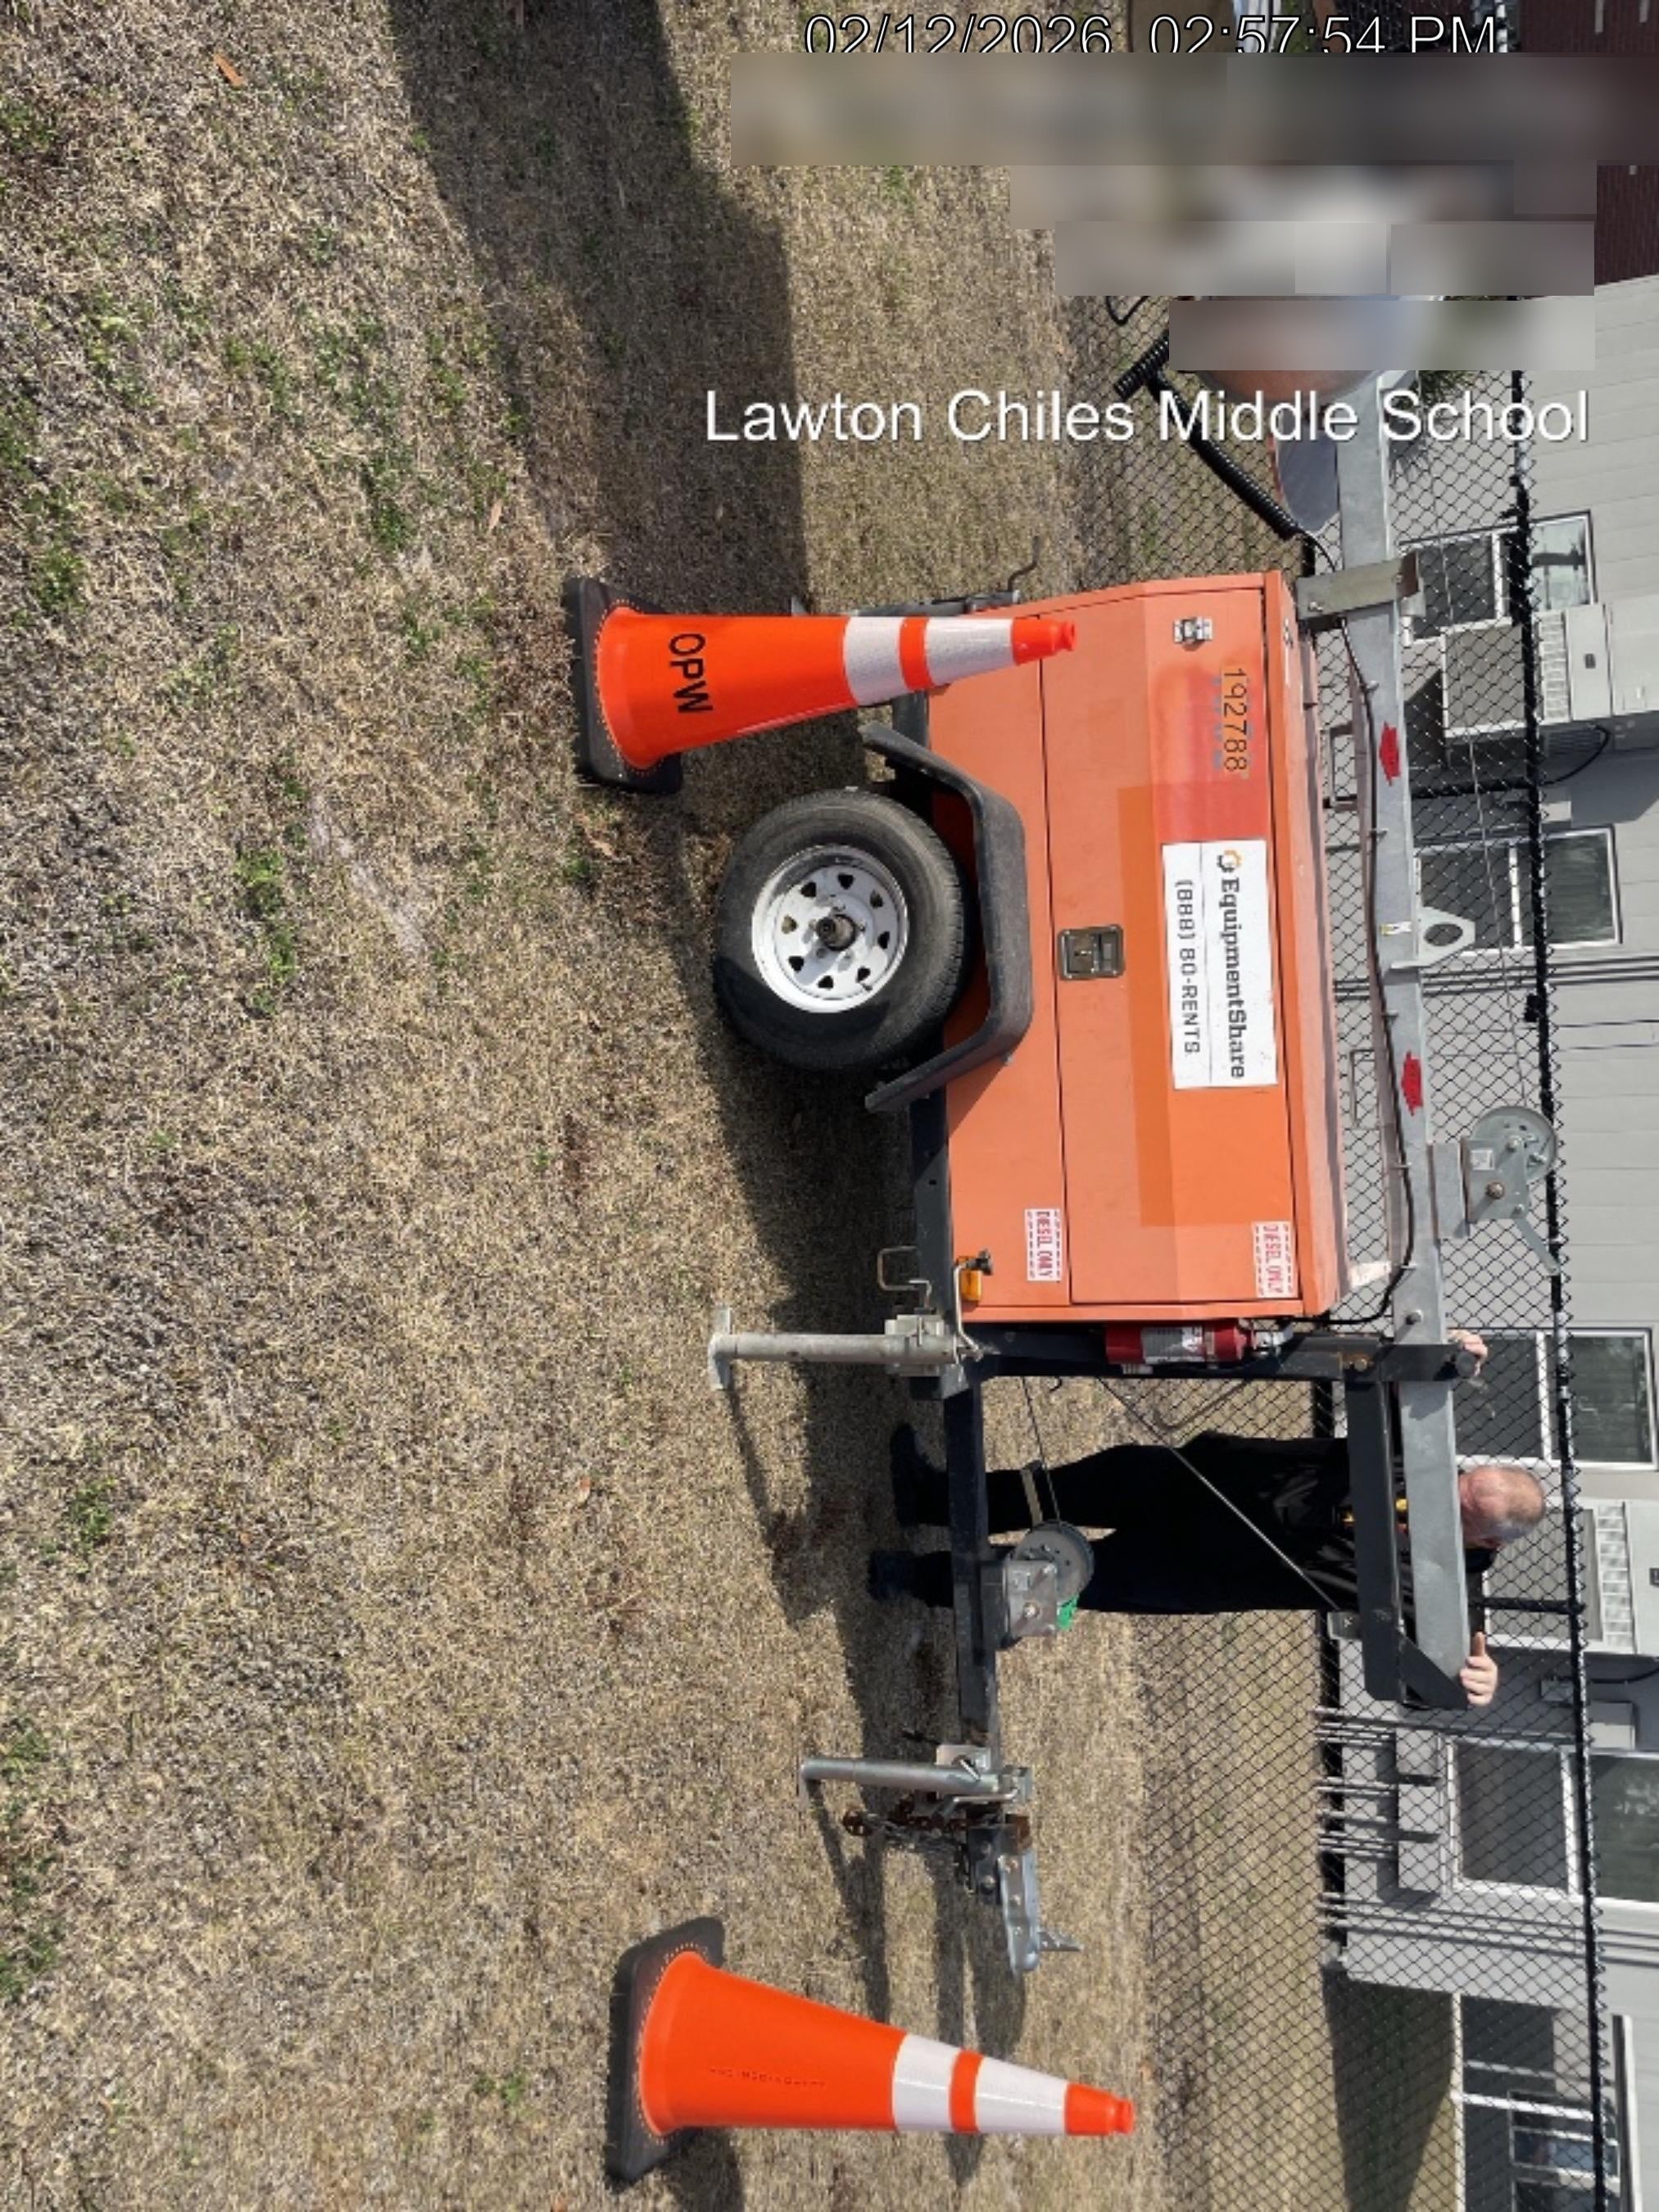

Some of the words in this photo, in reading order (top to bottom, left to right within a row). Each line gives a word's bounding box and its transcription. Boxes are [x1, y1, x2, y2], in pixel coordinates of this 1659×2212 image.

[669, 633, 714, 714] OPW
[1223, 667, 1248, 772] 192788
[1176, 879, 1197, 940] (888)
[1178, 947, 1202, 1054] 80-RENTS
[1217, 877, 1248, 1079] EquipmentShare
[1036, 1211, 1053, 1249] DIESEL
[1262, 1225, 1282, 1263] DIESEL
[1036, 1250, 1054, 1278] ONLY
[1265, 1265, 1284, 1294] ONLY
